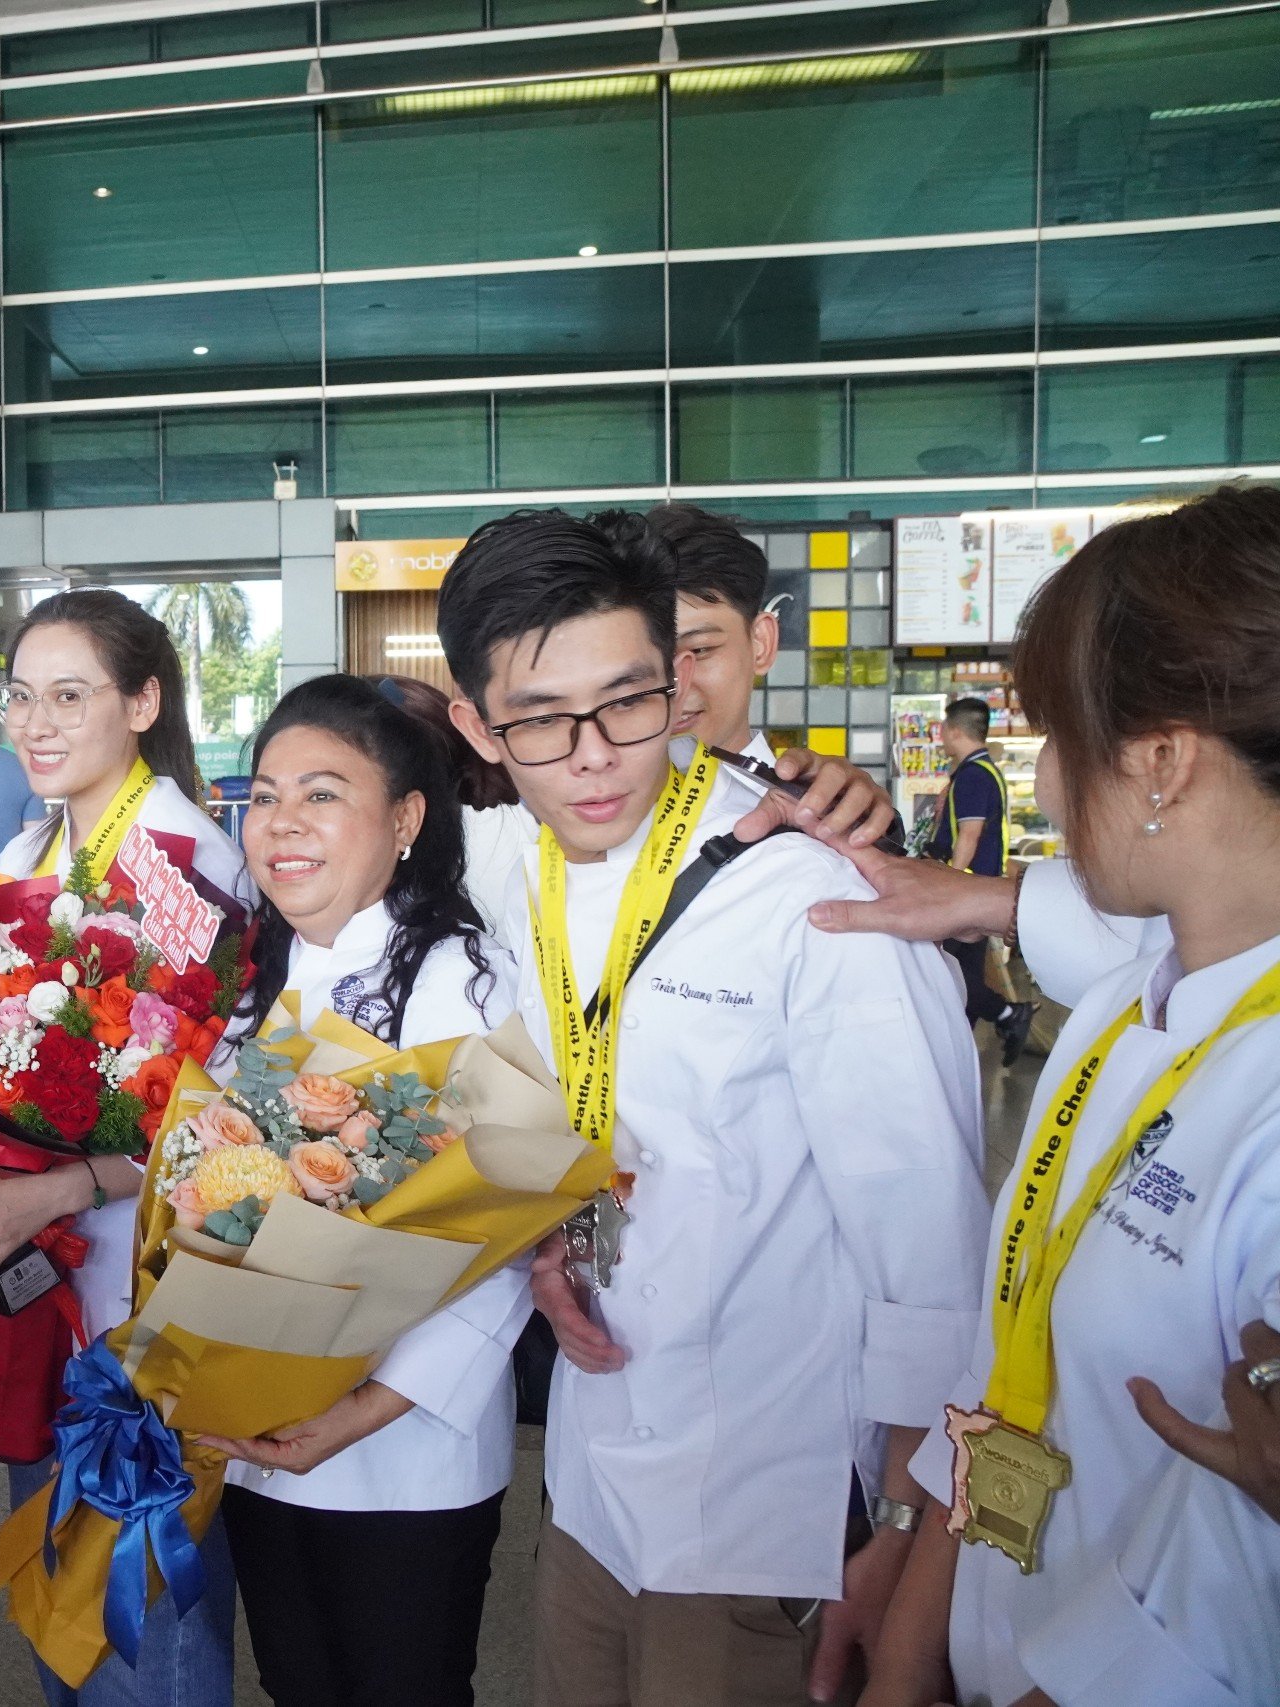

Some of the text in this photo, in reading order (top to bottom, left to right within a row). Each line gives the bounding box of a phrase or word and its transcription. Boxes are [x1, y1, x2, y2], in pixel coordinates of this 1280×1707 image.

[694, 763, 706, 784] of
[116, 804, 127, 819] of
[126, 786, 144, 804] the
[680, 786, 700, 817] the
[658, 822, 687, 876] Chefs
[679, 982, 713, 1004] Quang
[568, 1011, 581, 1046] the
[573, 1072, 593, 1133] Battle
[999, 1055, 1100, 1303] Battle of the Chefs
[1138, 1178, 1153, 1191] OF
[1152, 1160, 1185, 1184] WORLD
